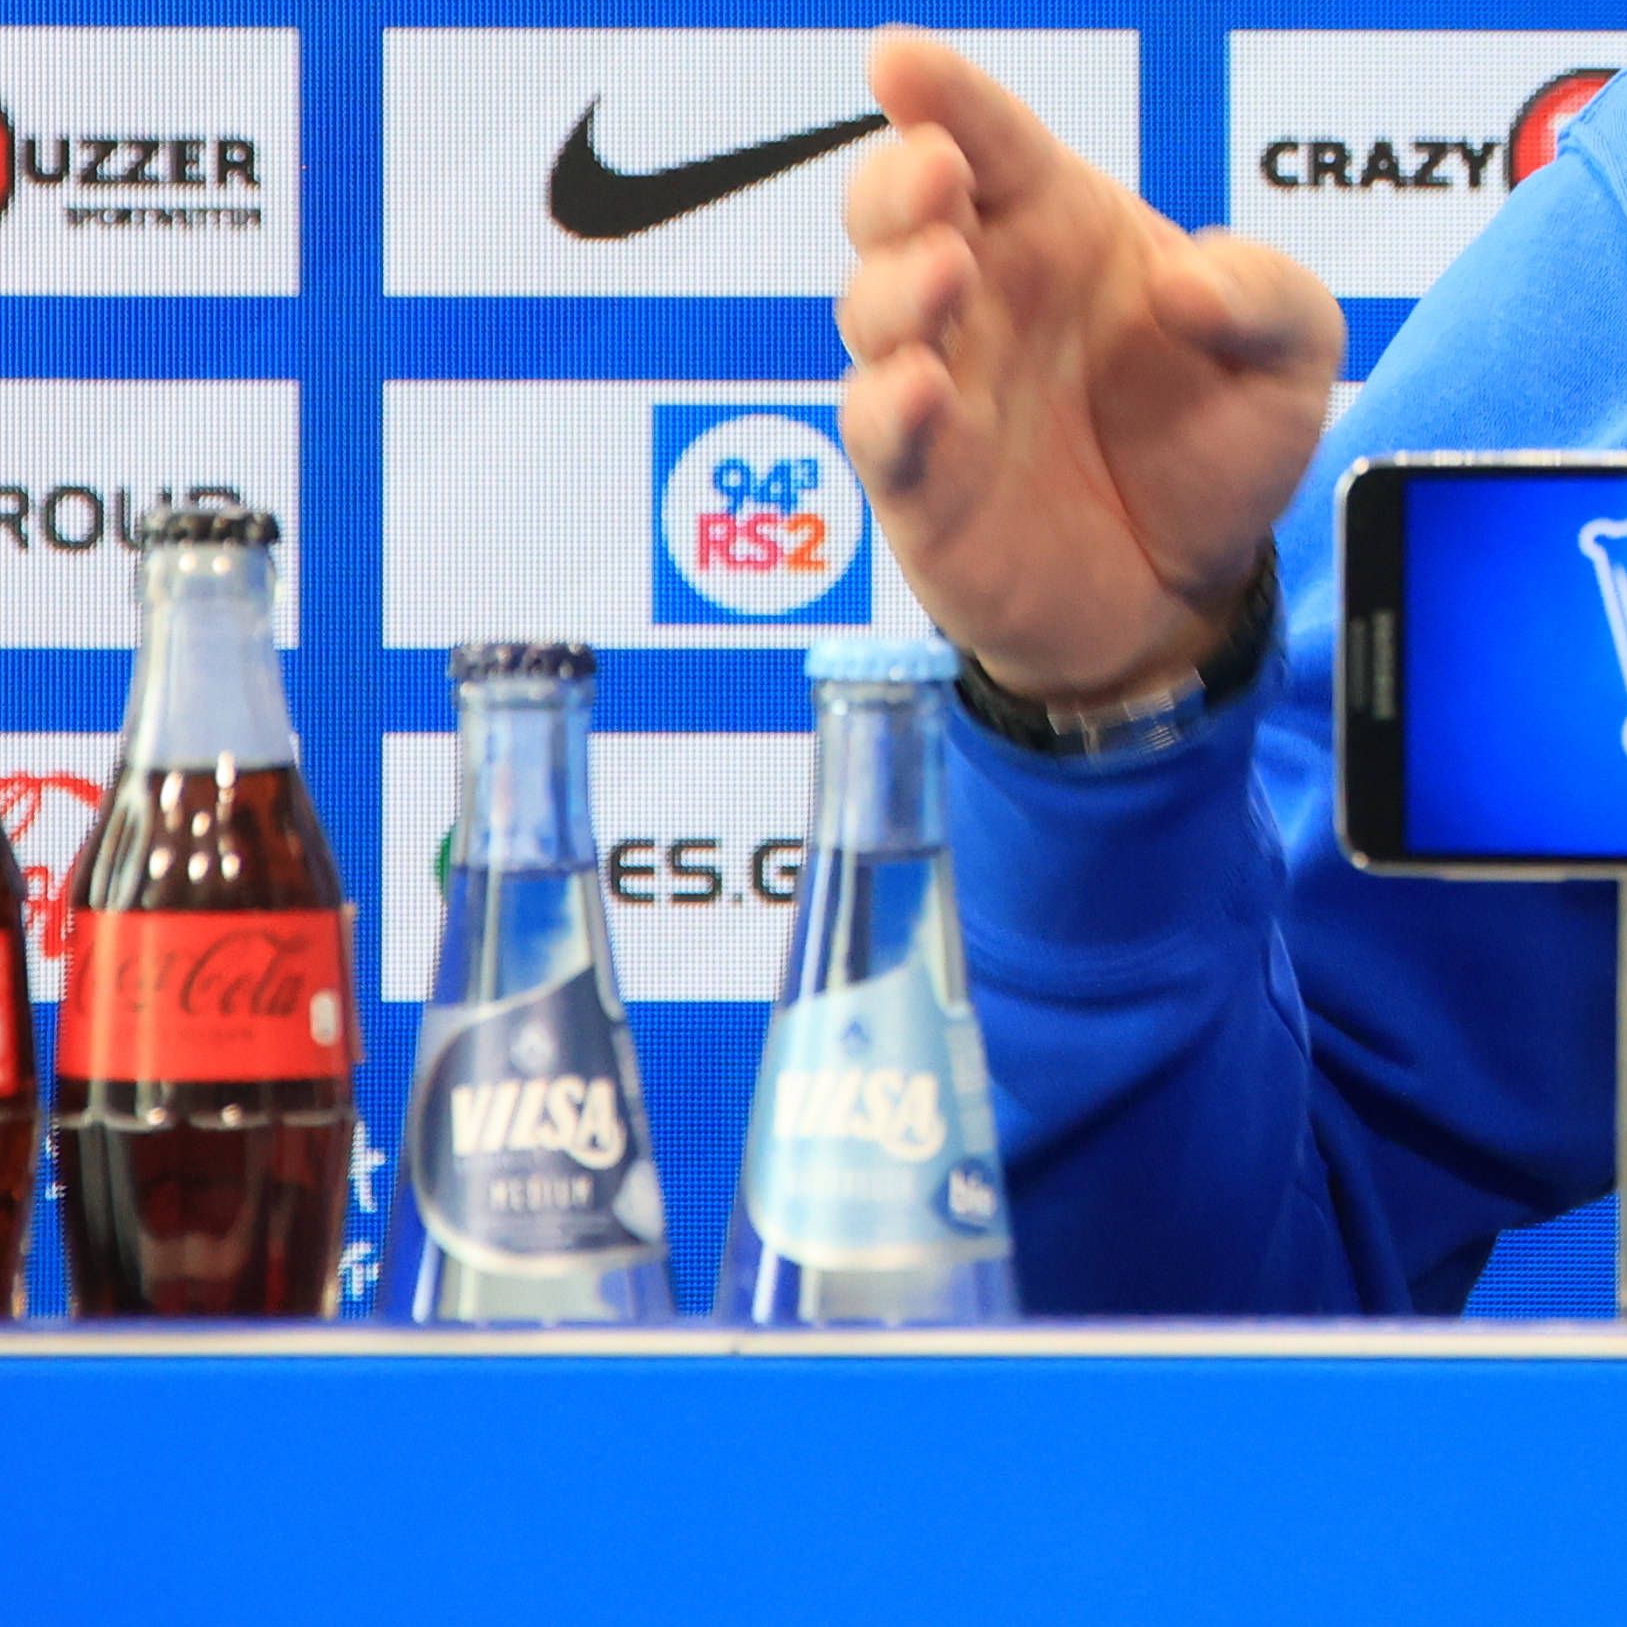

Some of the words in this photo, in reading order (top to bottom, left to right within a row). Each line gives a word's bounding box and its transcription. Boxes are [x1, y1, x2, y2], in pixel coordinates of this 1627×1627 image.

[1261, 140, 1500, 189] CRAZY
[699, 513, 826, 571] RS2
[451, 1075, 628, 1170] VILSA
[773, 1067, 947, 1162] VILSA
